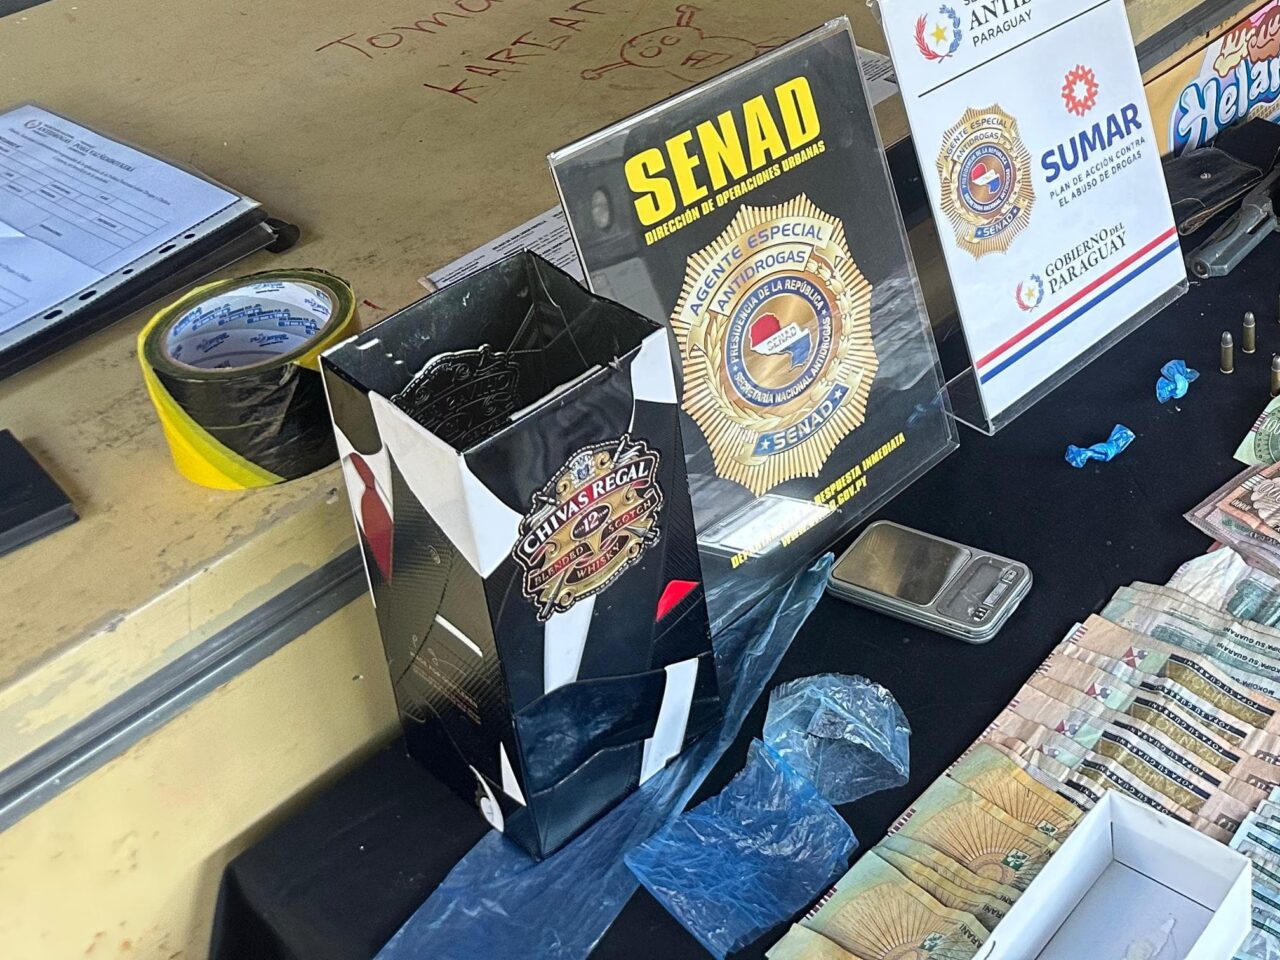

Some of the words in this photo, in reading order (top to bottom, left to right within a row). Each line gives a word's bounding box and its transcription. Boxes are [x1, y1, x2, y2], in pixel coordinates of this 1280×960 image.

[972, 9, 1032, 47] PARAGUAY
[624, 76, 821, 226] SENAD
[944, 128, 969, 162] AGENTE
[970, 117, 1008, 130] ESPECIAL
[956, 132, 999, 161] ANTIDROGAS
[1041, 103, 1142, 183] SUMAR
[1049, 182, 1071, 200] PLAN
[1072, 175, 1084, 187] DE
[1085, 156, 1115, 180] ACCIÓN
[1115, 136, 1146, 159] CONTRA
[1058, 196, 1070, 208] EL
[1071, 180, 1098, 201] ABUSO
[1099, 172, 1111, 184] DE
[1111, 150, 1143, 175] DROGAS
[644, 207, 700, 246] DIRECCIÓN
[702, 199, 716, 216] DE
[716, 165, 781, 207] OPERACIONES
[781, 140, 826, 172] URBANAS
[982, 214, 1015, 237] SENAD
[1045, 228, 1109, 277] GOBIERNO
[1109, 222, 1125, 238] DEL
[690, 245, 743, 317] AGENTE
[747, 222, 823, 249] ESPECIAL
[716, 249, 807, 313] ANTIDROGAS
[1048, 231, 1129, 296] PARAGUAY
[730, 296, 759, 364] PRESIDENCIA
[757, 285, 770, 300] DE
[771, 280, 783, 292] LA
[774, 379, 813, 404] NACIONAL
[811, 316, 832, 381] ANTIDROGAS
[773, 400, 834, 451] SENAD
[813, 465, 862, 506] RESPUESTA
[861, 431, 907, 472] INMEDIATA
[523, 491, 590, 555] CHIVAS
[592, 461, 650, 499] REGAL
[582, 510, 601, 532] 12
[534, 546, 585, 586] BLENDED
[608, 500, 652, 533] SCOTCH
[576, 540, 621, 580] WHISKY
[1248, 657, 1260, 666] SU
[1255, 640, 1266, 648] SU
[1194, 707, 1206, 717] SU
[1224, 685, 1234, 695] SU
[1168, 750, 1179, 760] SU
[1189, 727, 1200, 737] SU
[1158, 765, 1169, 775] SU
[1137, 793, 1148, 802] SU
[958, 922, 984, 949] ARANI
